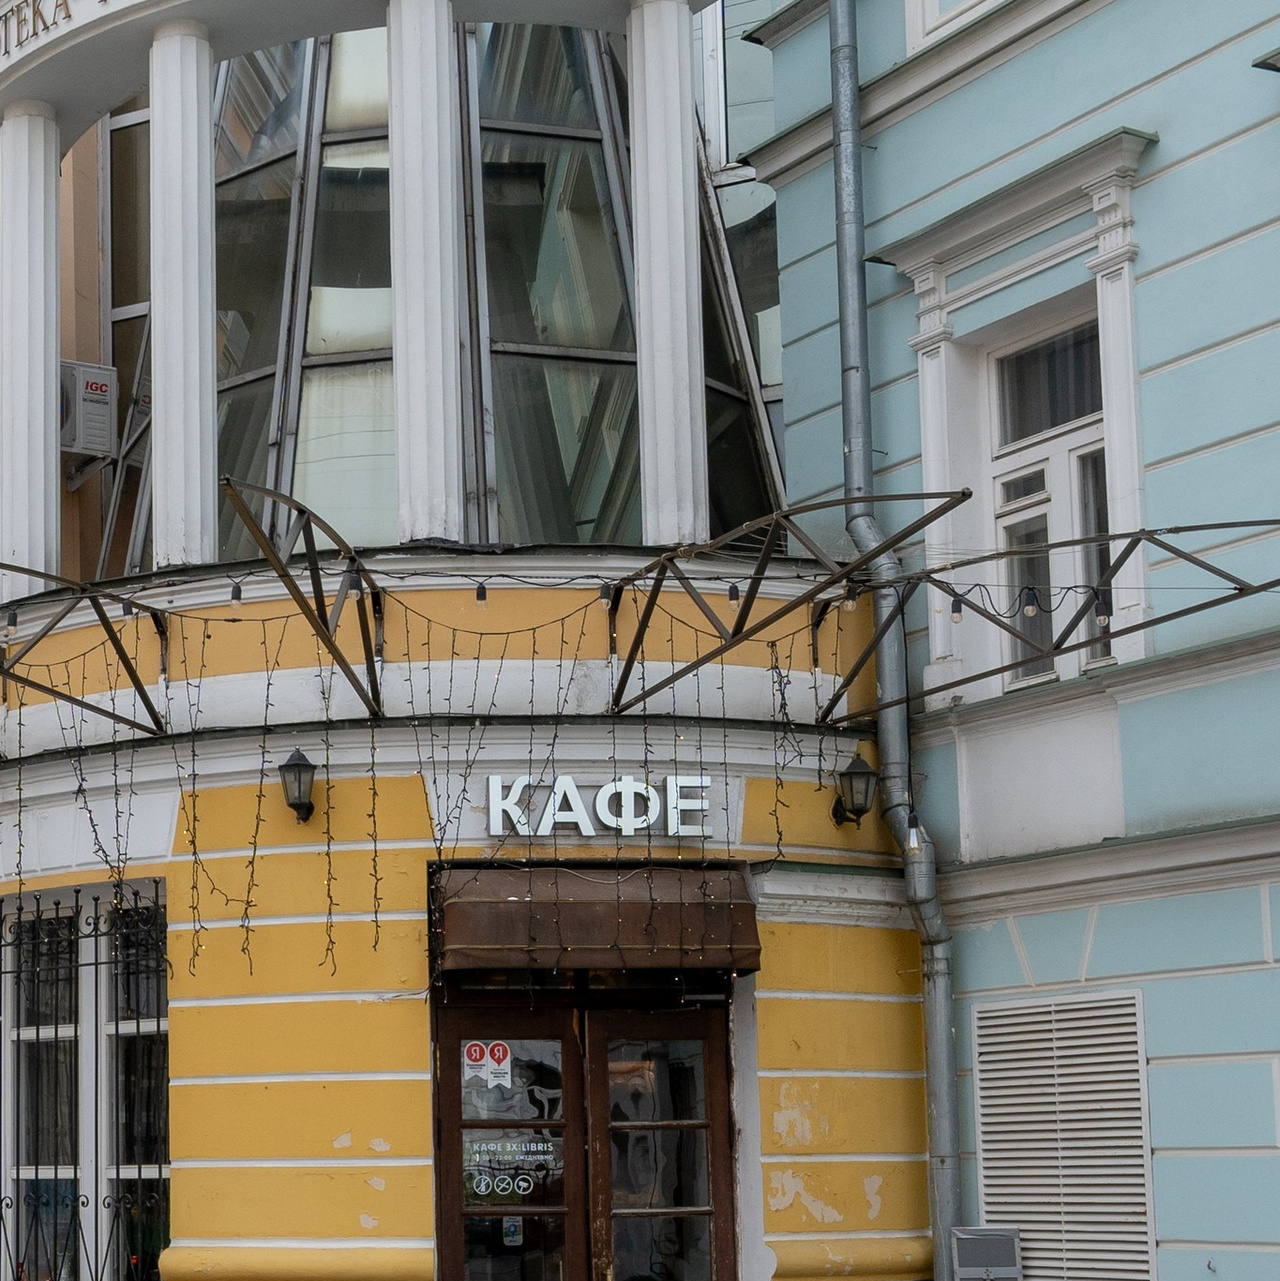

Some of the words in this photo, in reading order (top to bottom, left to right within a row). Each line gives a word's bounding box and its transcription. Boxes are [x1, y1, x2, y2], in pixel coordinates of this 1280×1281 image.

[85, 381, 108, 394] IGC
[488, 774, 714, 837] КАФЕ
[471, 1046, 480, 1060] Я
[493, 1046, 504, 1059] Я
[473, 1142, 503, 1152] КАФЕ
